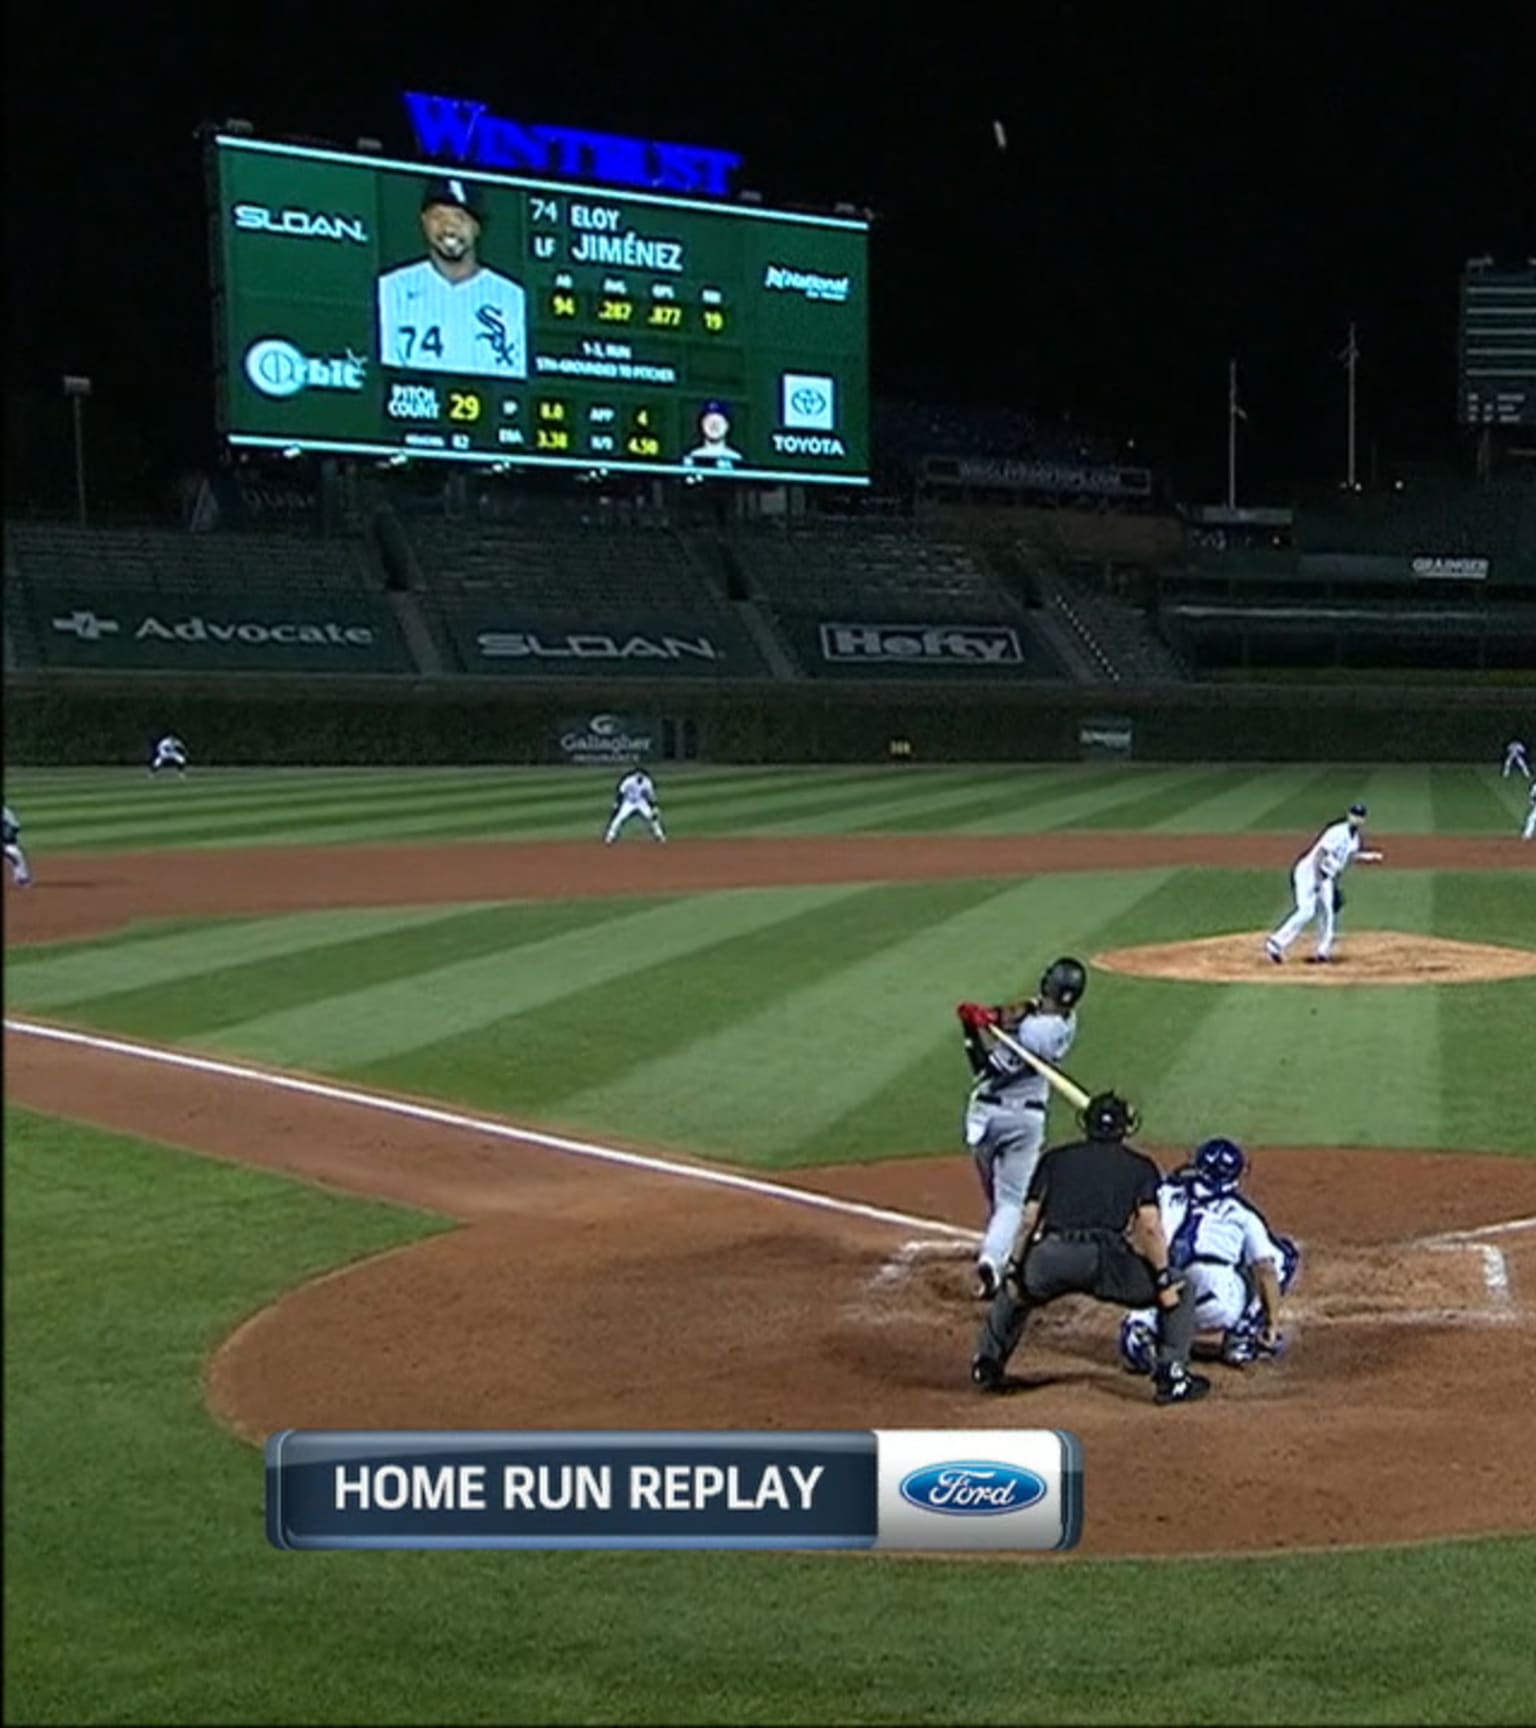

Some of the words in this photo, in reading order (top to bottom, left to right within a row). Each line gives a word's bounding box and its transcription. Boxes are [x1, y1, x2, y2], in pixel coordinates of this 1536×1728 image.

[530, 198, 558, 222] 74
[570, 205, 620, 231] ELOY
[534, 236, 556, 258] LF
[571, 231, 683, 271] JIMÉNEZ
[399, 326, 443, 359] 74
[450, 393, 481, 421] 29
[772, 435, 846, 457] TOYOTA
[135, 616, 374, 644] Advocate
[833, 625, 1004, 661] Hefty
[560, 732, 653, 753] Gallagher
